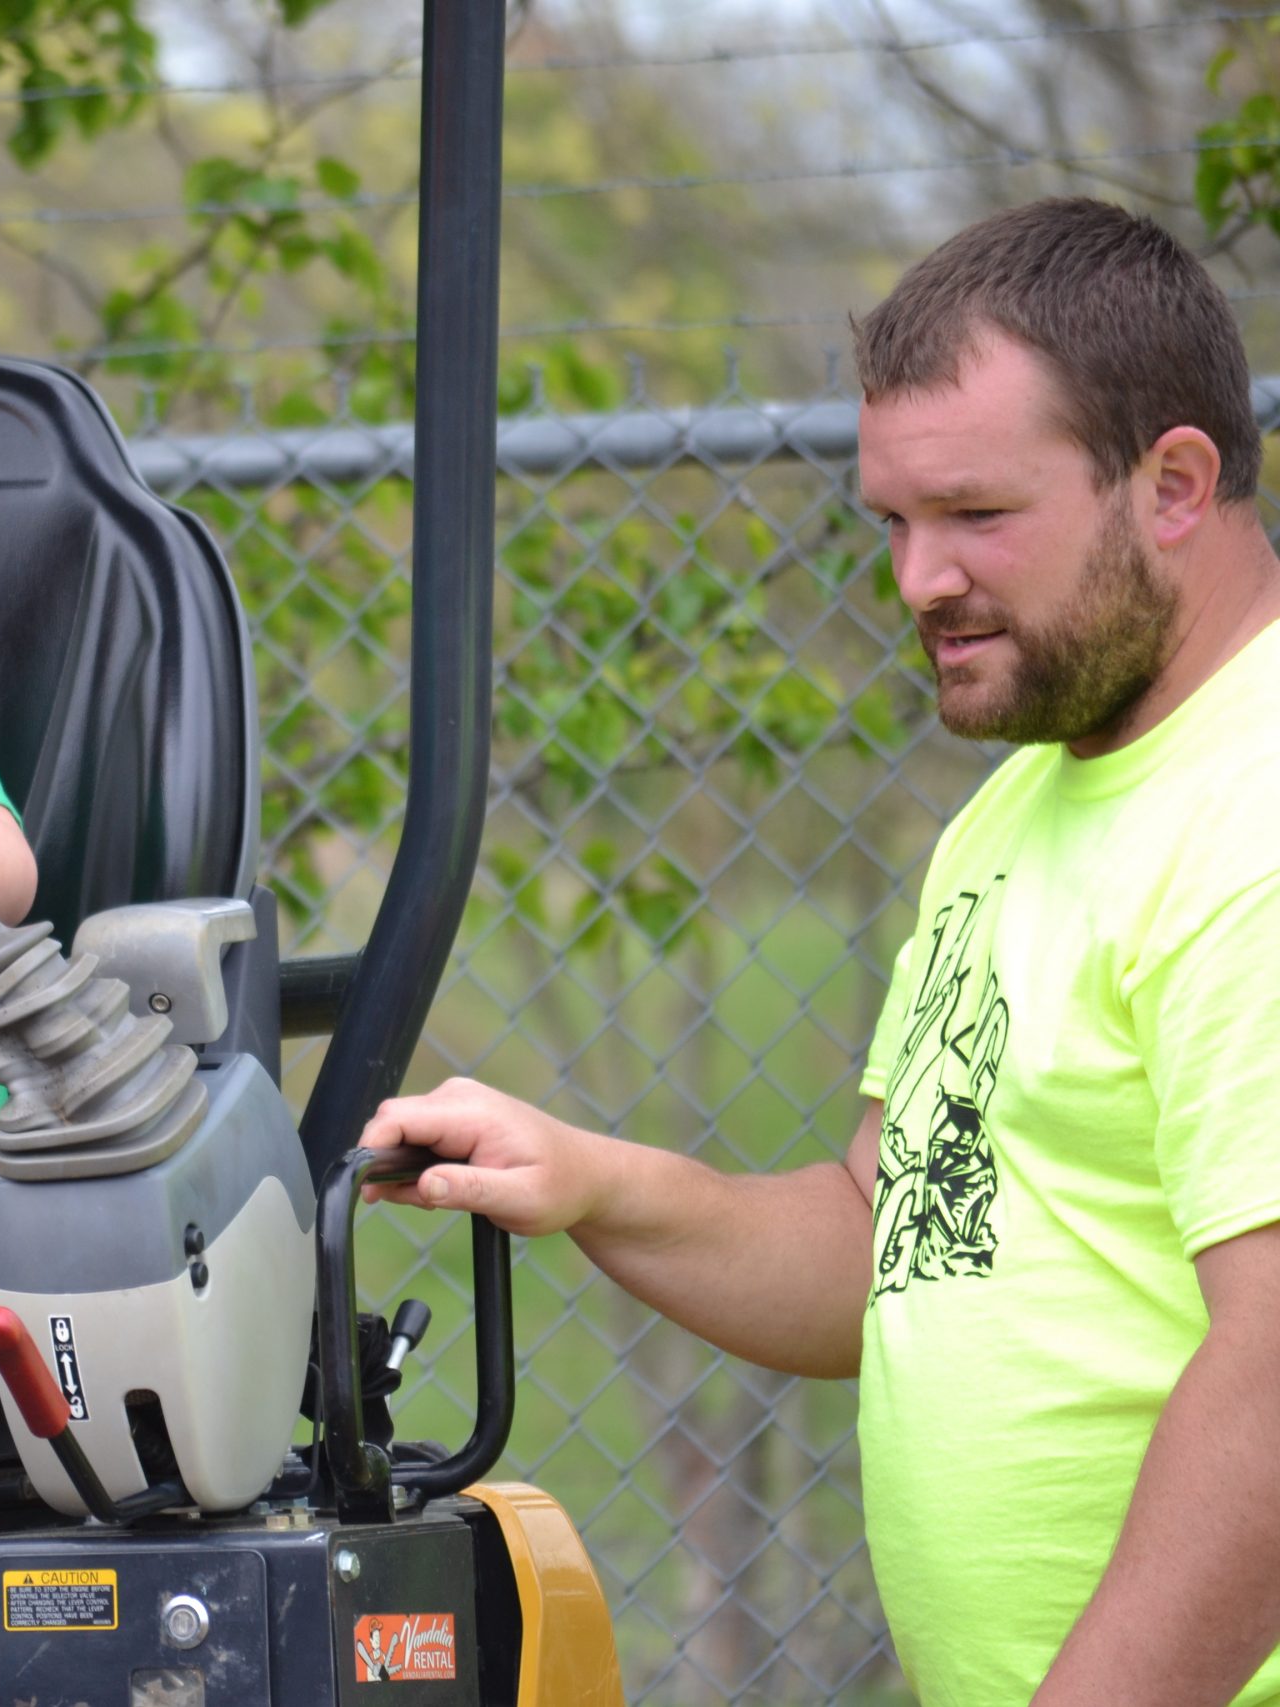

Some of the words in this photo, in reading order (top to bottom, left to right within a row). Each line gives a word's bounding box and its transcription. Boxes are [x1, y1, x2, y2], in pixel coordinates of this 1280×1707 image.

[55, 1344, 74, 1352] LOCK
[41, 1572, 99, 1584] CAUTION
[400, 1615, 454, 1669] Vandalia
[413, 1650, 454, 1669] RENTAL
